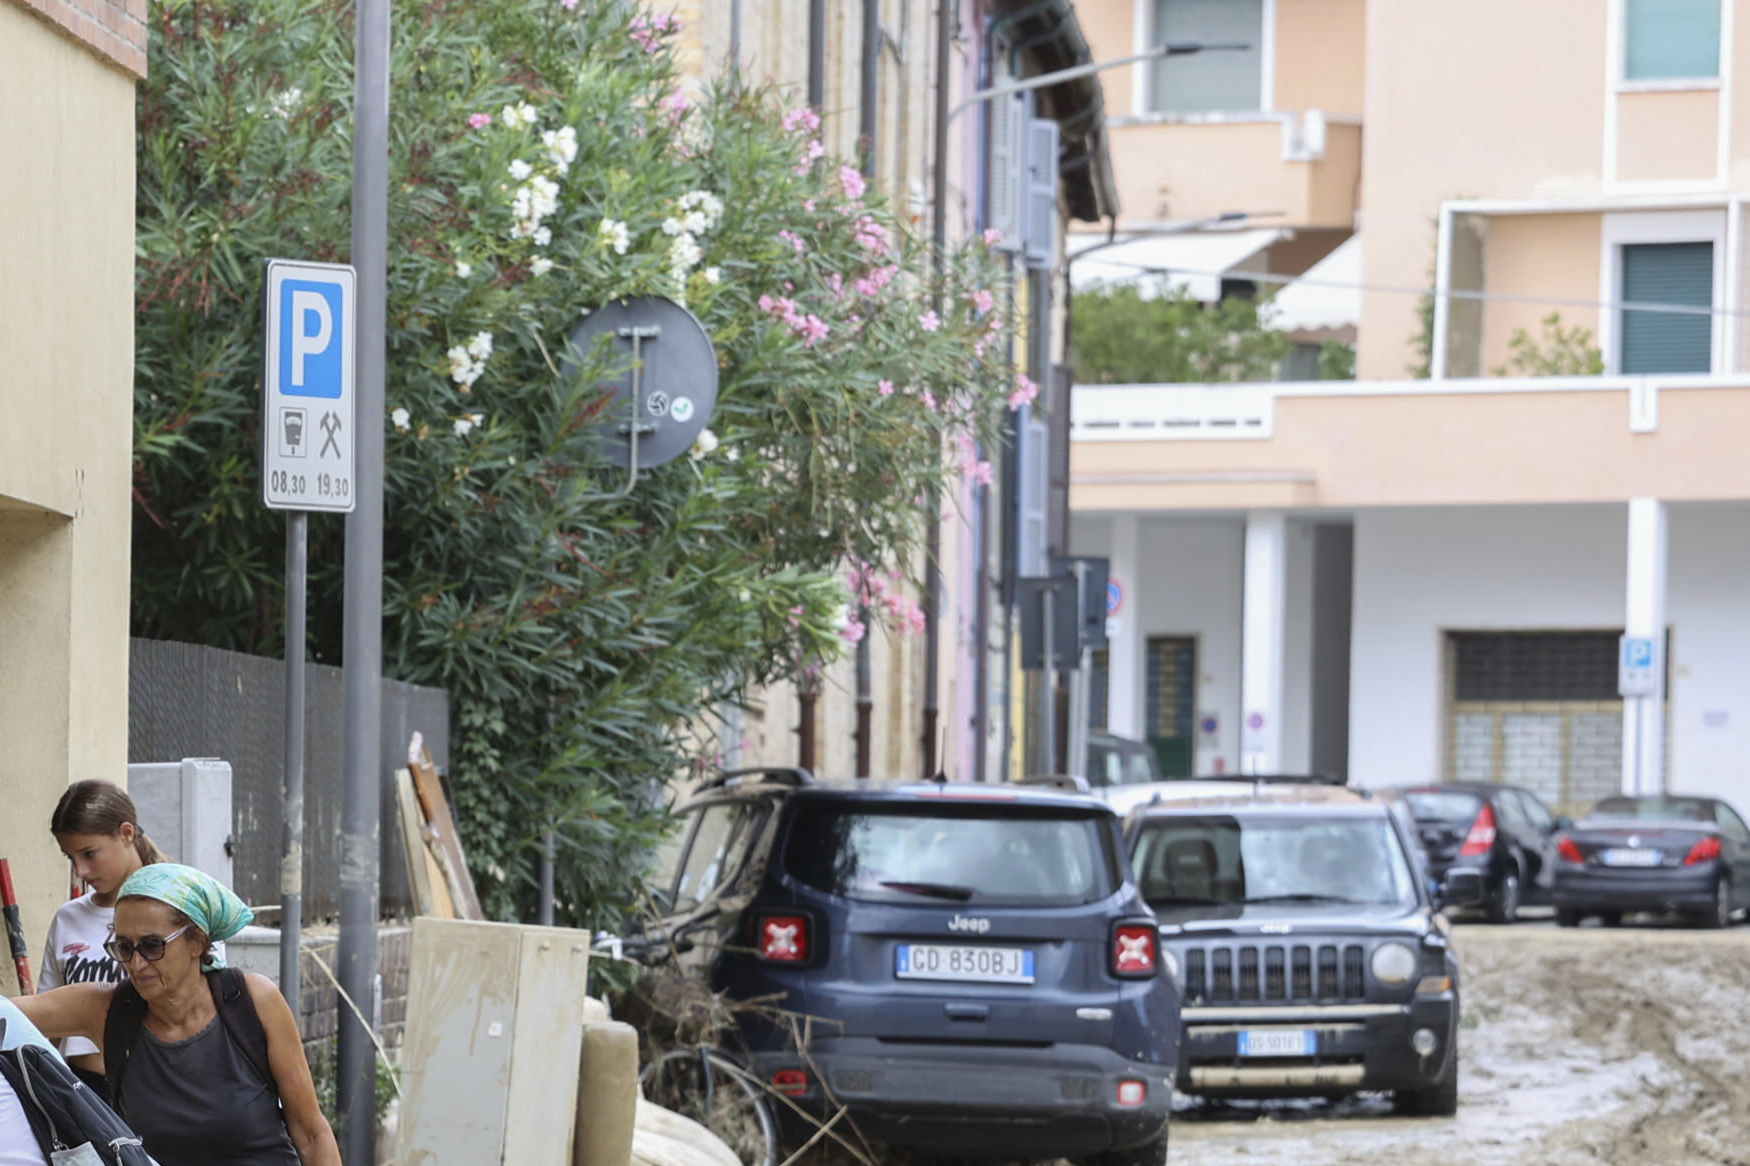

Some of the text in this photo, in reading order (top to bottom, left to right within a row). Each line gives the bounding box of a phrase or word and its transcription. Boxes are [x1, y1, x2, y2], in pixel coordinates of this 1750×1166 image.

[291, 290, 333, 386] P
[1630, 642, 1647, 666] P
[947, 914, 991, 934] Jeep
